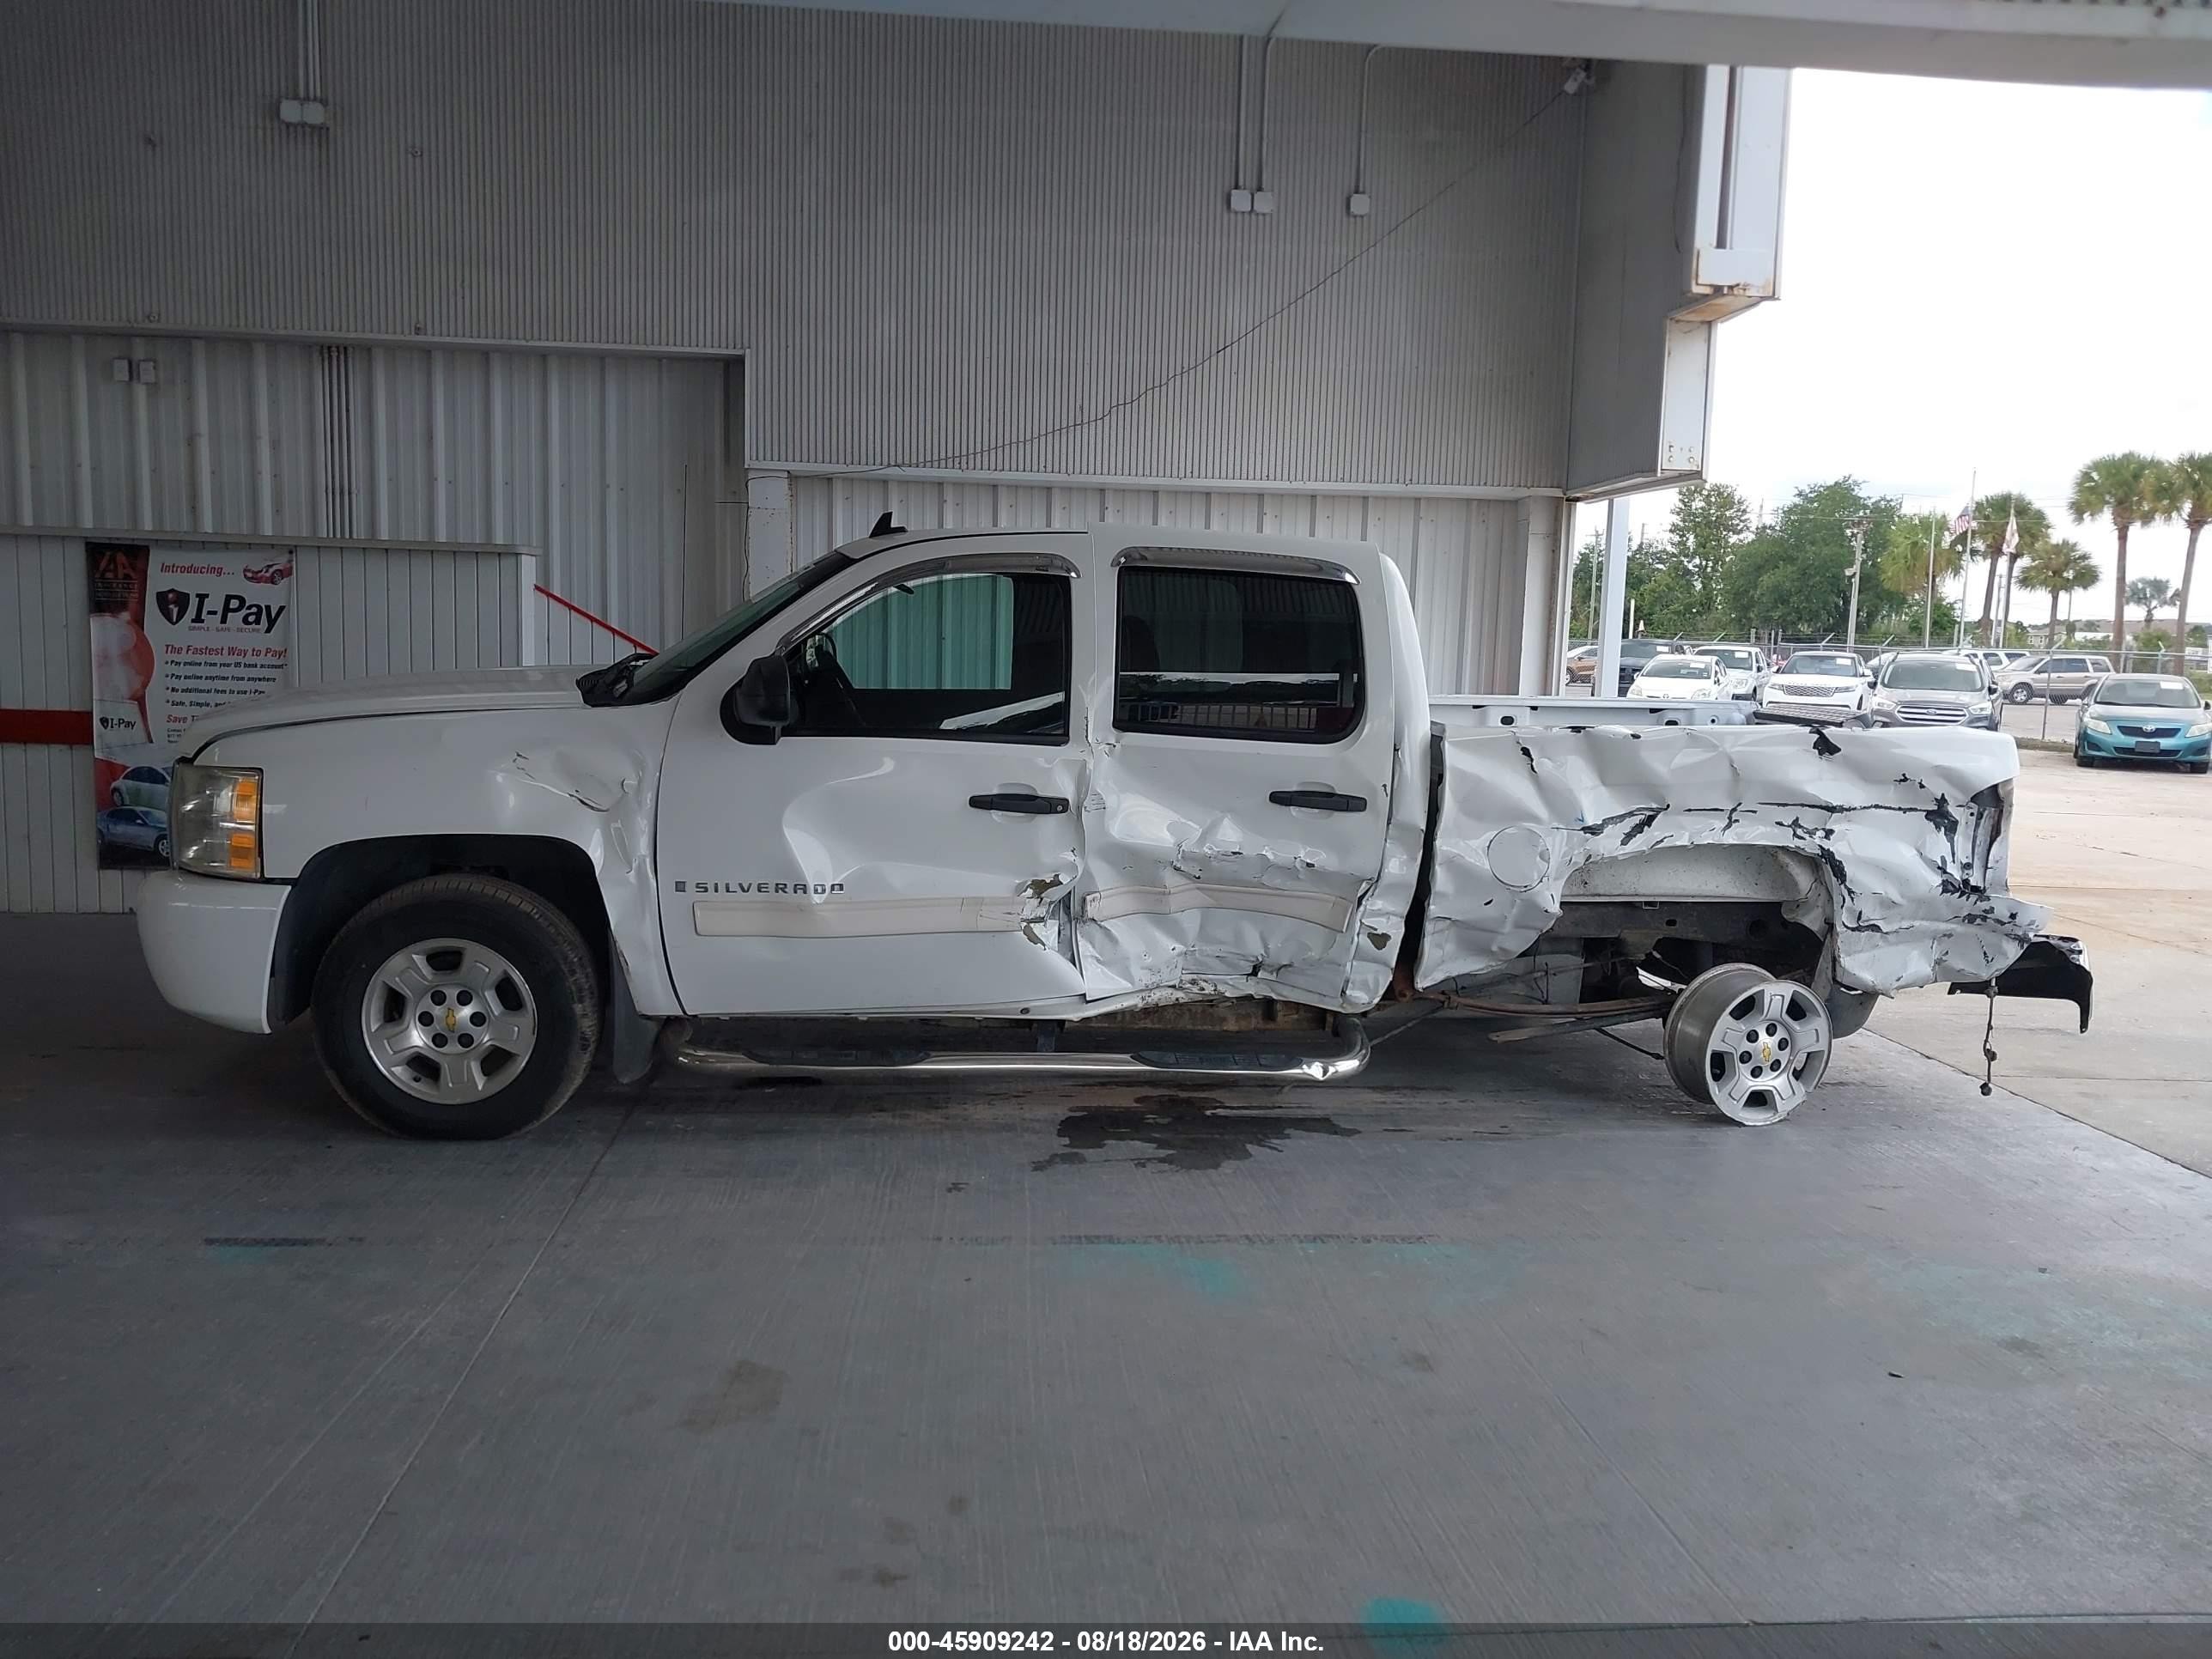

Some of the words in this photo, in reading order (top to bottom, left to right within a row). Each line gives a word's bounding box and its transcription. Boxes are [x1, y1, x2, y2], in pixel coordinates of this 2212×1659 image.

[160, 562, 234, 577] Introducing...
[191, 592, 287, 634] I-Pay
[165, 644, 183, 654] The
[185, 645, 224, 656] Fastest
[228, 646, 248, 658] Way
[252, 647, 261, 657] to
[264, 647, 288, 659] Pay!
[110, 718, 137, 730] I-Pay
[166, 714, 188, 723] Save
[695, 882, 845, 895] SILVERADO
